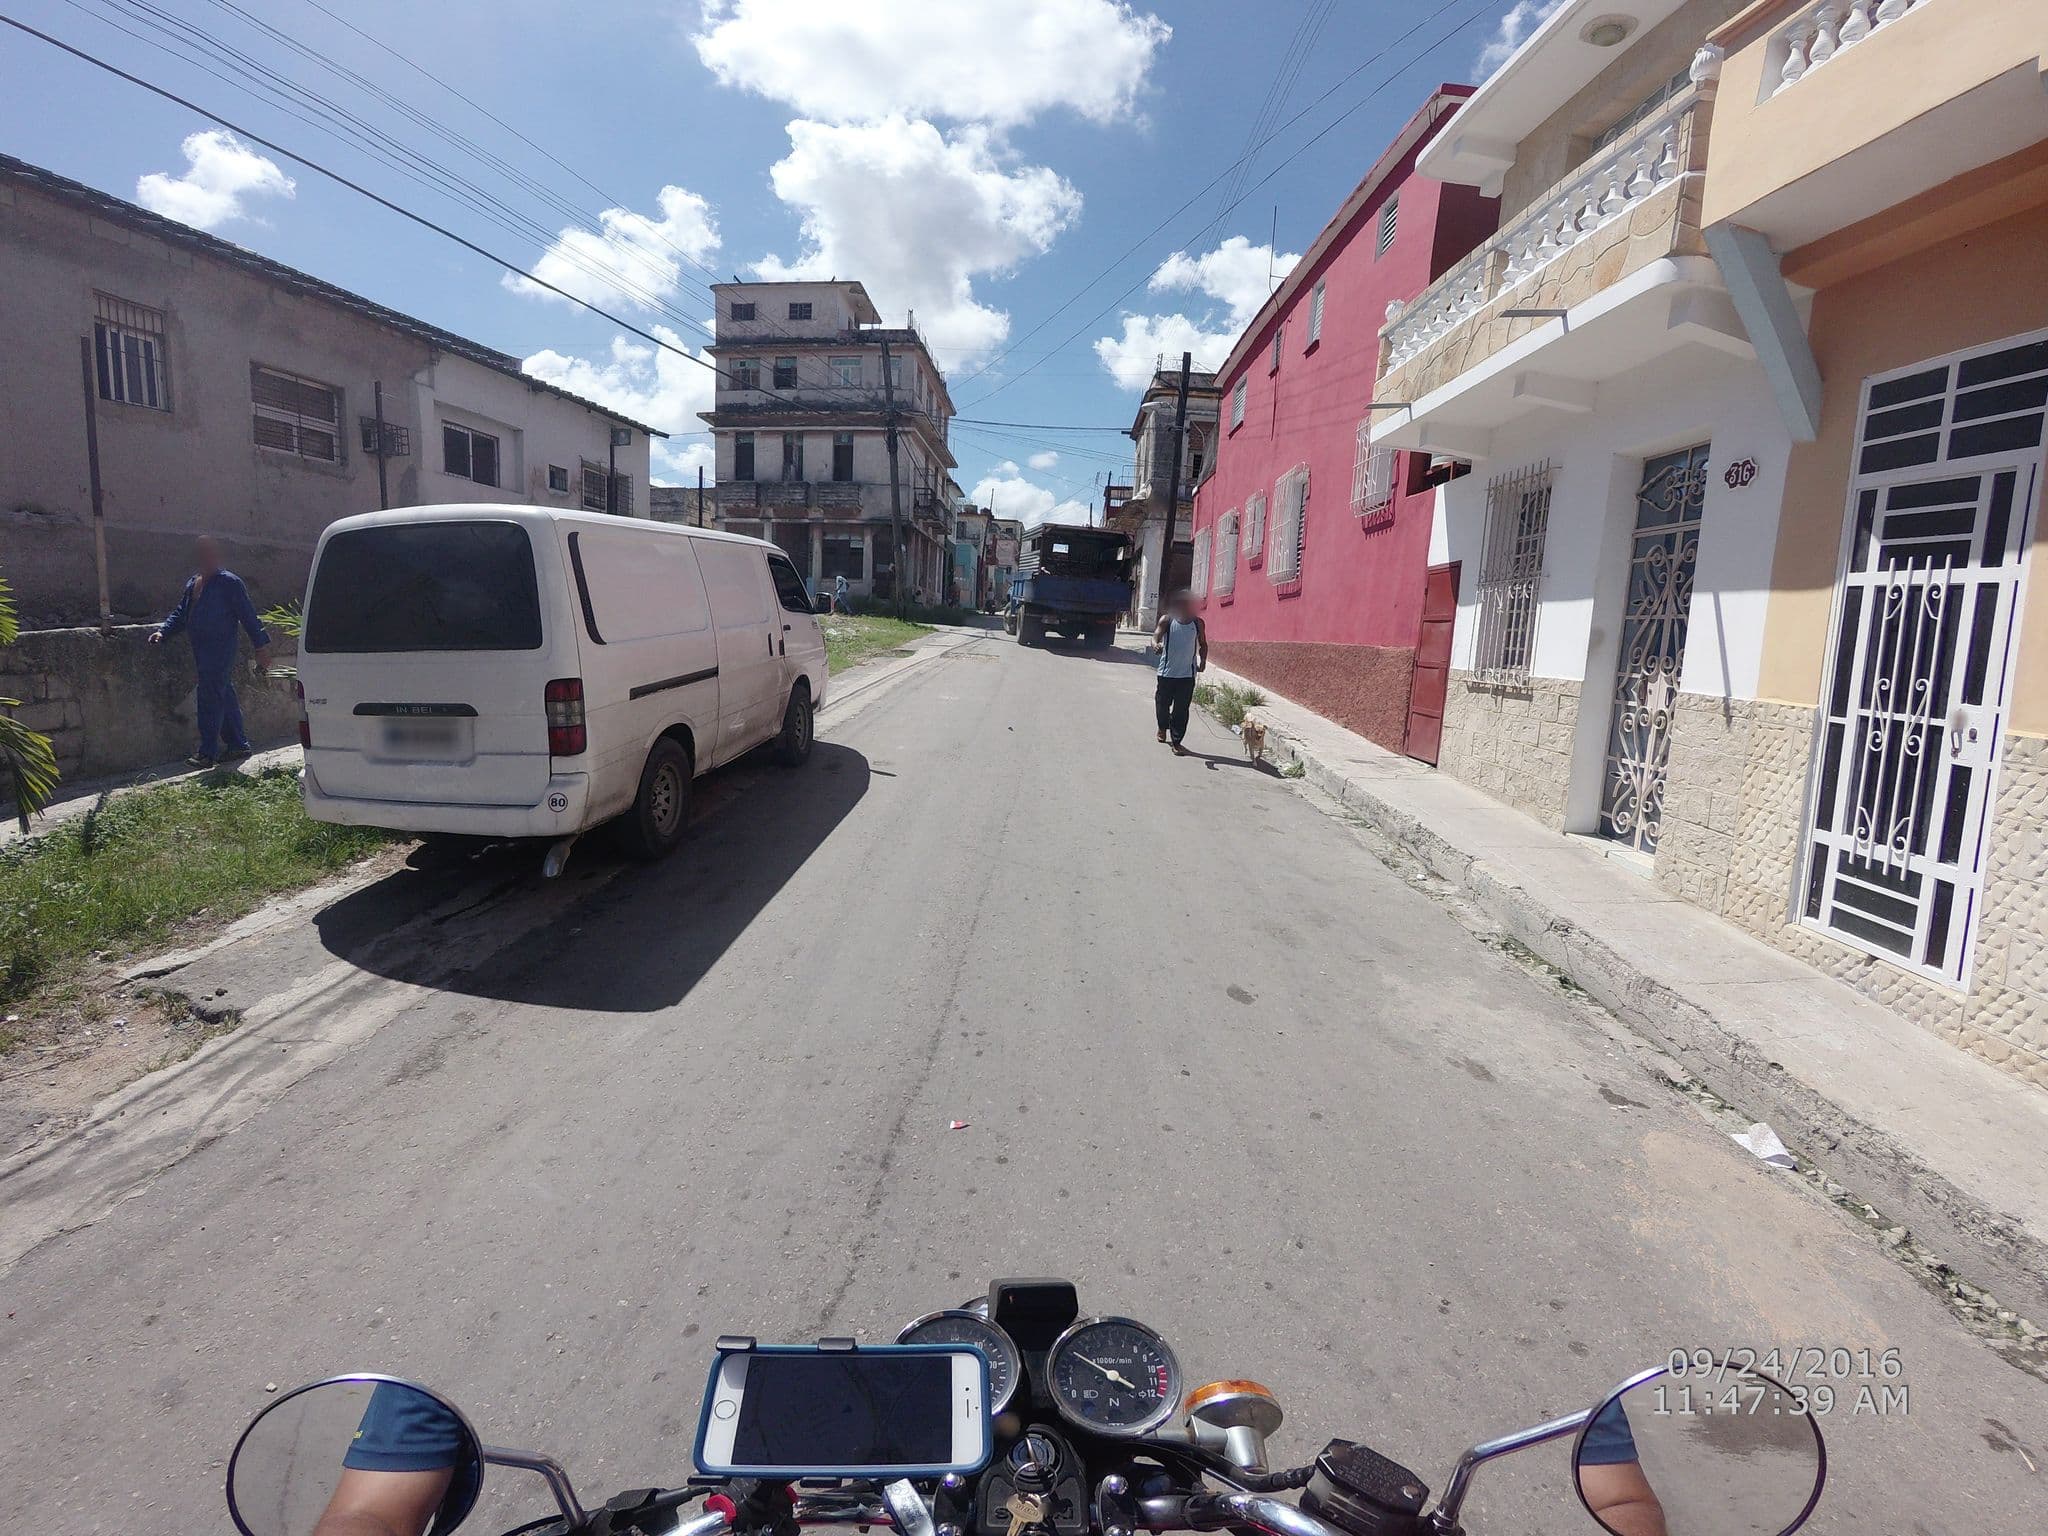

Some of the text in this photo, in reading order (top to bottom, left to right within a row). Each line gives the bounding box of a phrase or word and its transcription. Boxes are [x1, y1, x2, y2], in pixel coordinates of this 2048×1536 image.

[1728, 463, 1752, 485] 316
[550, 797, 566, 807] 80
[1142, 1354, 1148, 1363] 9
[1147, 1365, 1156, 1374] 10
[1149, 1377, 1158, 1386] 11
[1147, 1389, 1156, 1398] 12
[1109, 1397, 1120, 1407] N
